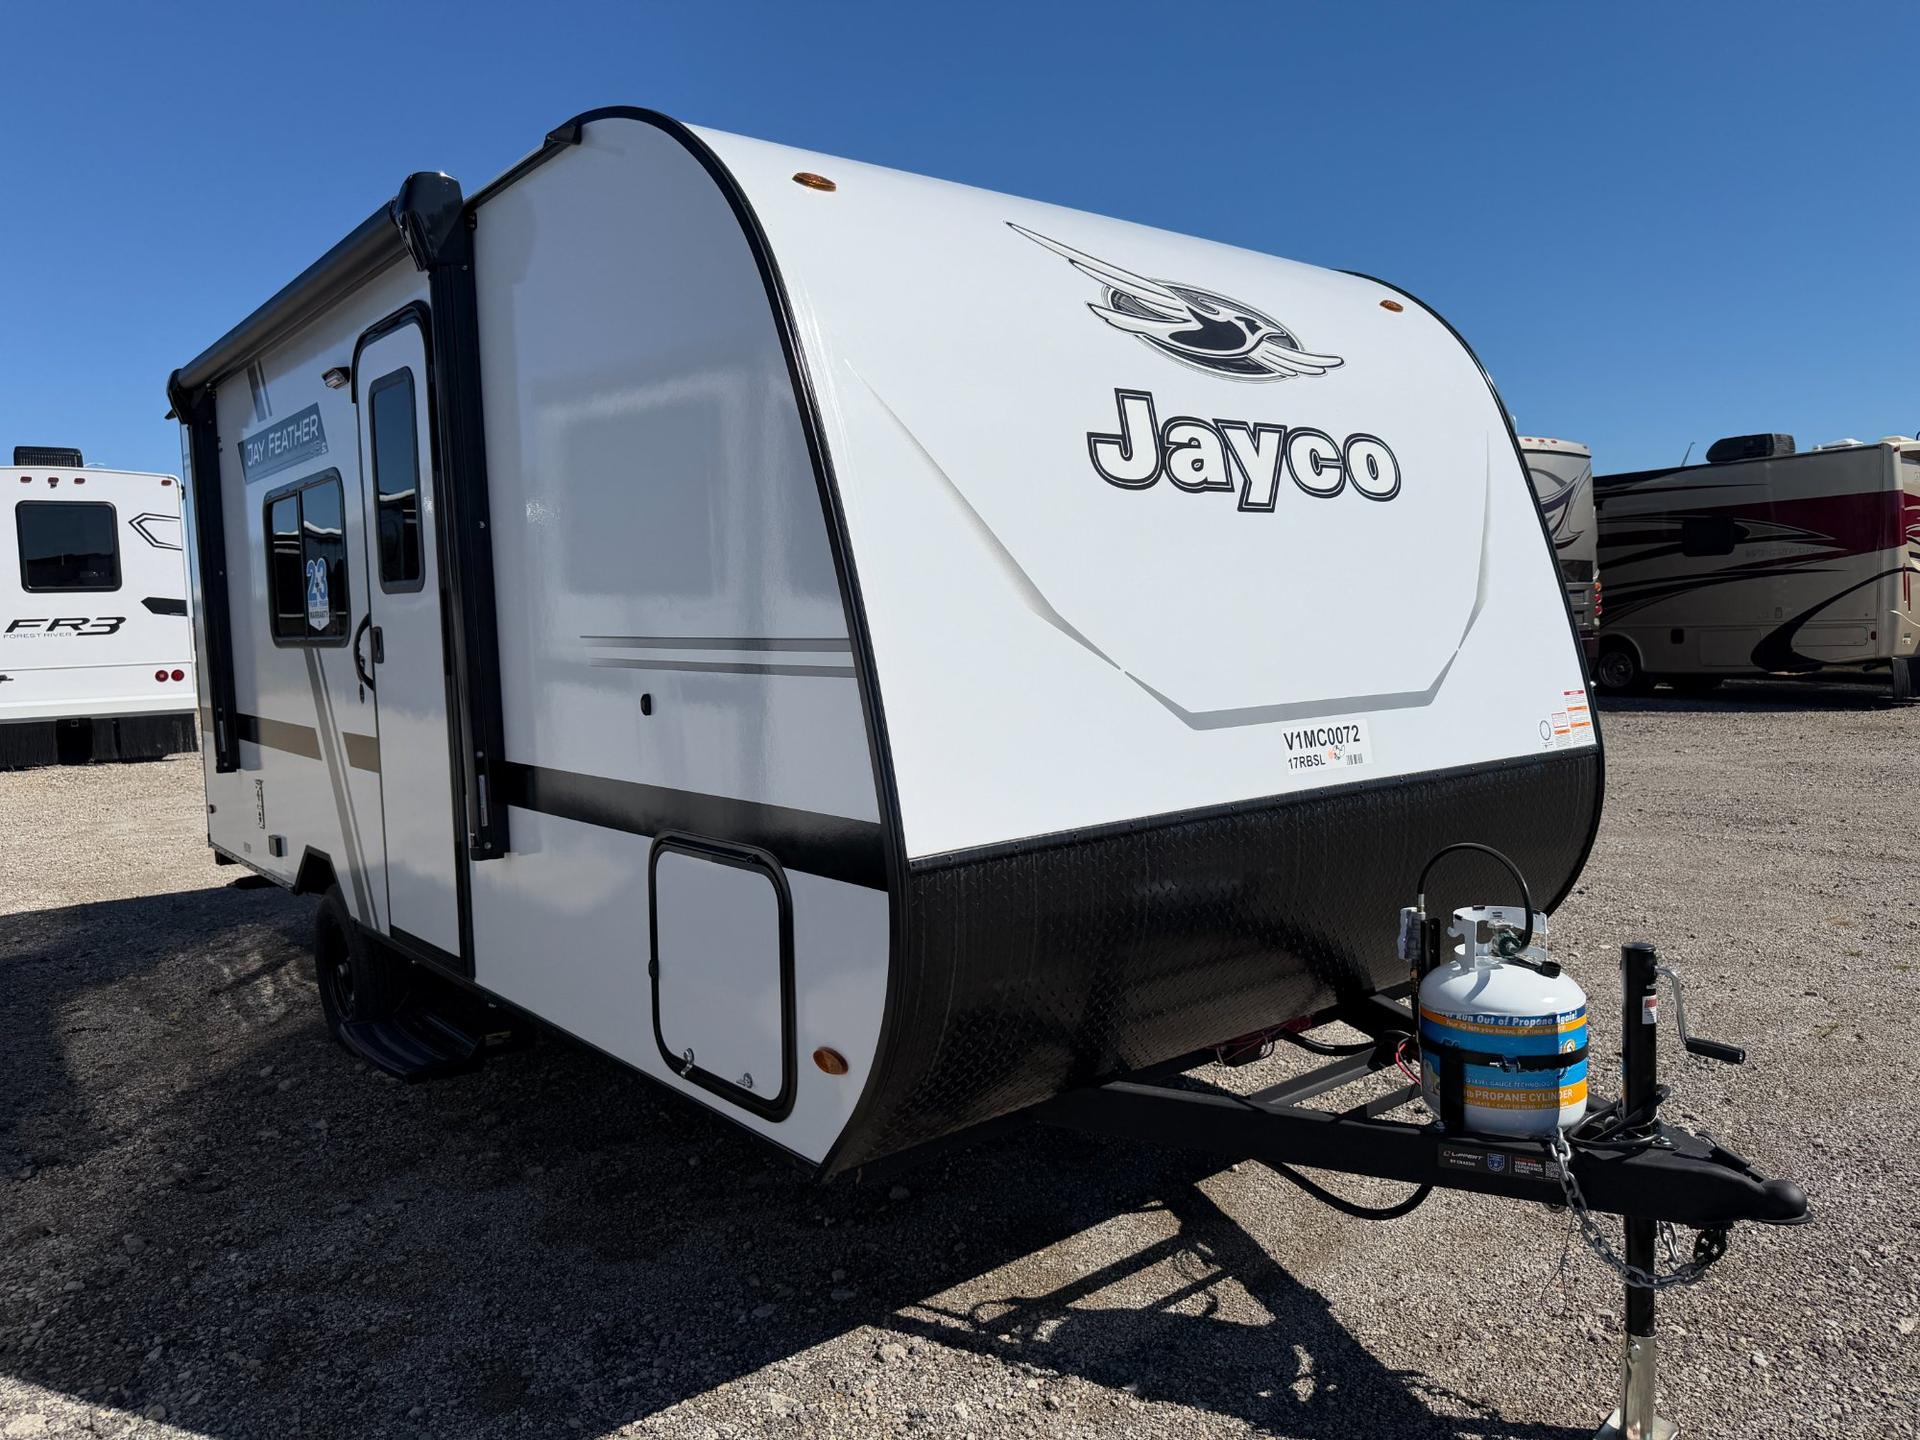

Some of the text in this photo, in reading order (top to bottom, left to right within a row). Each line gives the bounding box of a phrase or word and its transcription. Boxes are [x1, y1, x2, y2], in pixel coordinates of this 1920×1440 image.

[247, 440, 265, 467] JAY
[268, 414, 318, 457] FEATHER
[1087, 388, 1401, 513] Jayco
[5, 616, 127, 637] FR3
[1283, 725, 1361, 751] V1MC0072
[1288, 754, 1326, 770] 17RBSL
[1477, 1015, 1495, 1025] Out
[1498, 1016, 1510, 1026] of
[1512, 1016, 1553, 1028] Propane
[1475, 1090, 1527, 1102] PROPANE
[1529, 1088, 1574, 1102] CYLINDER
